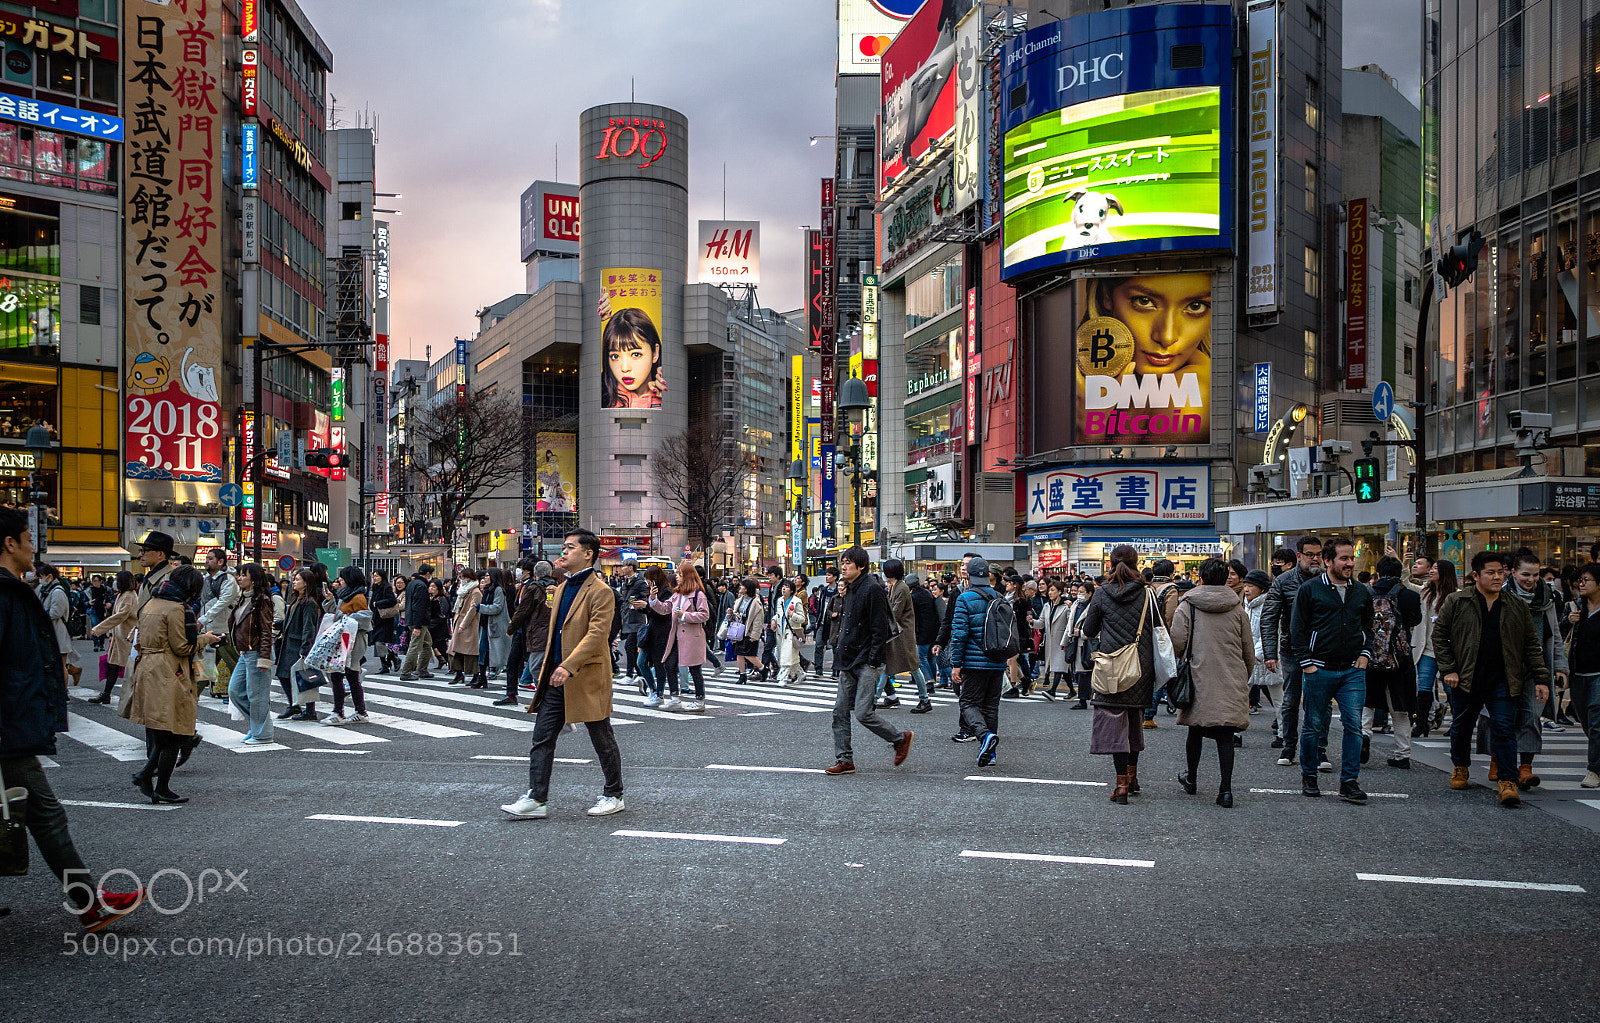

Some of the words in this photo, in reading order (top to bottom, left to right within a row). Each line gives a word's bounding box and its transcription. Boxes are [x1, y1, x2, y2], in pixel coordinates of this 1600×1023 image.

[22, 19, 101, 59] ガスト
[1007, 47, 1024, 66] DHC
[1024, 31, 1062, 56] Channel
[1056, 52, 1124, 93] DHC
[244, 77, 255, 110] ガスト
[1251, 39, 1272, 142] Taisei
[608, 117, 667, 130] SHIBUYA
[594, 126, 669, 169] 109
[1048, 146, 1170, 181] ニューススイート
[129, 15, 173, 345] 日本武道館だって。
[1251, 149, 1267, 233] neon
[548, 199, 580, 218] UNI
[378, 227, 387, 248] BIC
[706, 229, 753, 260] H&M
[1079, 247, 1099, 258] DHC
[710, 266, 739, 276] 150m
[1351, 204, 1364, 307] クスリのことなら
[1348, 316, 1365, 380] 三千里
[333, 388, 341, 408] レイク
[907, 366, 948, 396] Euphoria
[1085, 372, 1203, 410] DMM
[1257, 367, 1268, 430] 大盛堂商事ビル
[127, 397, 219, 439] 2018
[1084, 409, 1203, 435] Bitcoin
[0, 453, 36, 468] ANE
[138, 434, 206, 472] 3.11
[307, 500, 329, 525] LUSH
[1031, 475, 1198, 515] 大盛堂書店
[1554, 495, 1586, 508] 渋谷駅
